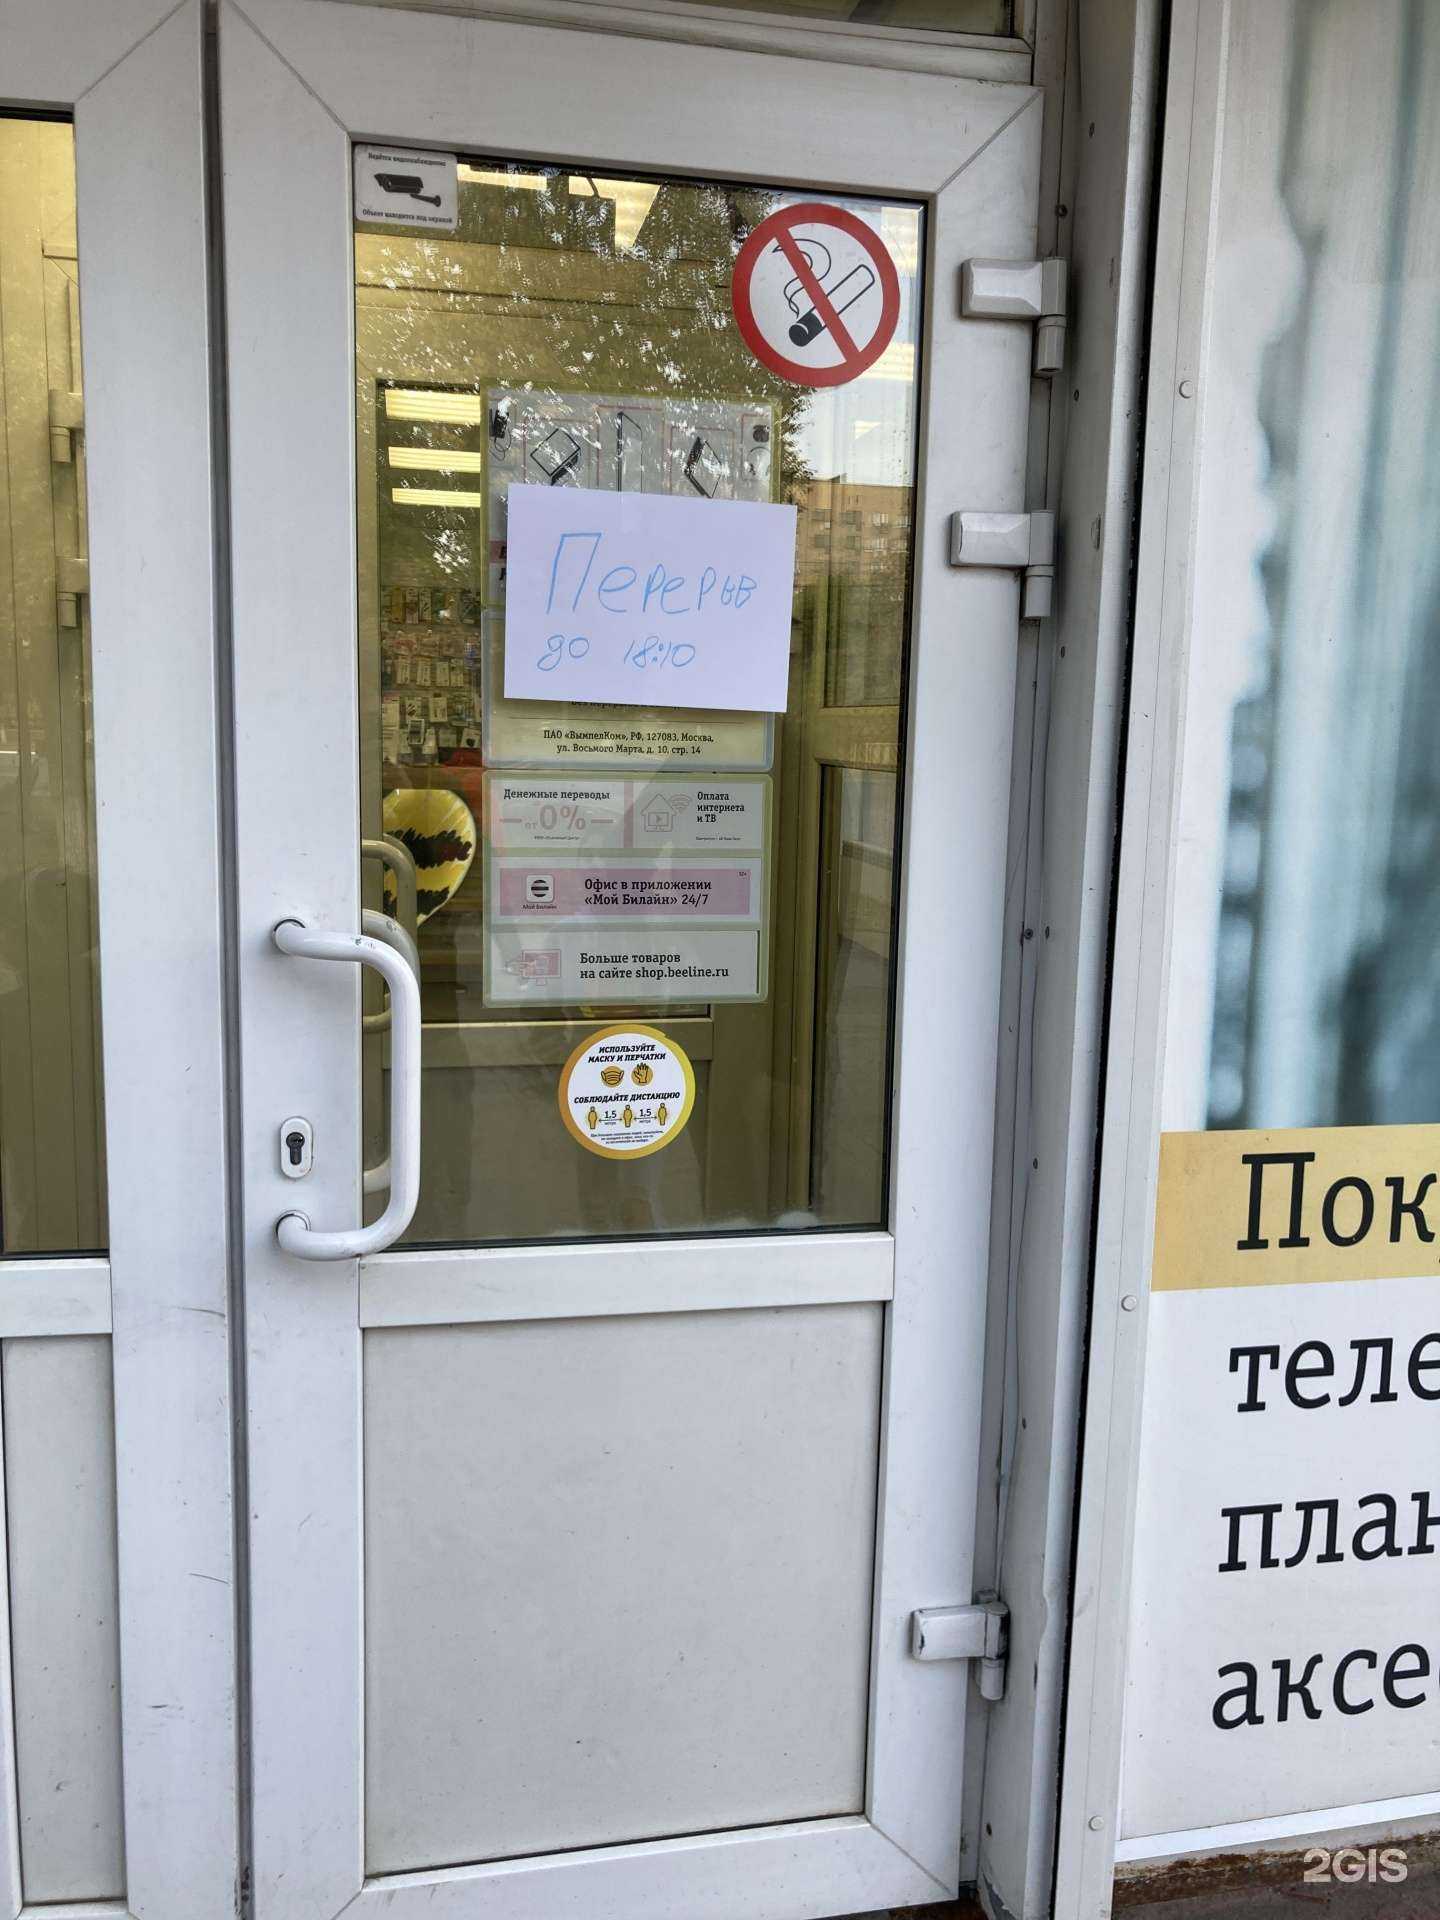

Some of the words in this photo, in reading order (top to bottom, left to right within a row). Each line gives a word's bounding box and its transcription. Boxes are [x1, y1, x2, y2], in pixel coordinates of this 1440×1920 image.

[546, 532, 758, 616] Перерыв
[623, 635, 697, 670] 18:10
[543, 729, 563, 740] ПАО
[556, 744, 571, 754] ул.
[573, 743, 614, 753] Восьмого
[691, 746, 701, 755] 14
[503, 788, 559, 801] Денежные
[560, 790, 611, 802] переводы
[697, 791, 730, 801] Оплата
[697, 804, 745, 814] интернета
[540, 804, 586, 831] 0%
[697, 815, 703, 823] и
[704, 813, 717, 823] ТВ
[584, 878, 618, 892] Офис
[621, 880, 629, 890] в
[631, 880, 712, 893] приложении
[584, 893, 619, 906] «Мой
[622, 893, 678, 906] Билайн»
[681, 894, 709, 907] 24/7
[580, 952, 629, 965] Больше
[631, 953, 681, 967] товаров
[580, 970, 595, 979] на
[598, 966, 632, 979] сайте
[635, 966, 729, 980] shop.beeline.ru
[598, 1043, 656, 1054] ИСПОЛЬЗУЙТЕ
[588, 1054, 615, 1064] МАСКУ
[616, 1054, 624, 1063] И
[625, 1052, 666, 1062] ПЕРЧАТКИ
[574, 1093, 629, 1104] СОБЛЮДАЙТЕ
[630, 1091, 681, 1102] ДИСТАНЦИЮ
[604, 1110, 617, 1120] 1,5
[640, 1108, 652, 1118] 1,5
[1237, 1152, 1440, 1264] Пок
[1229, 1333, 1440, 1412] теле
[1212, 1643, 1440, 1730] аксе
